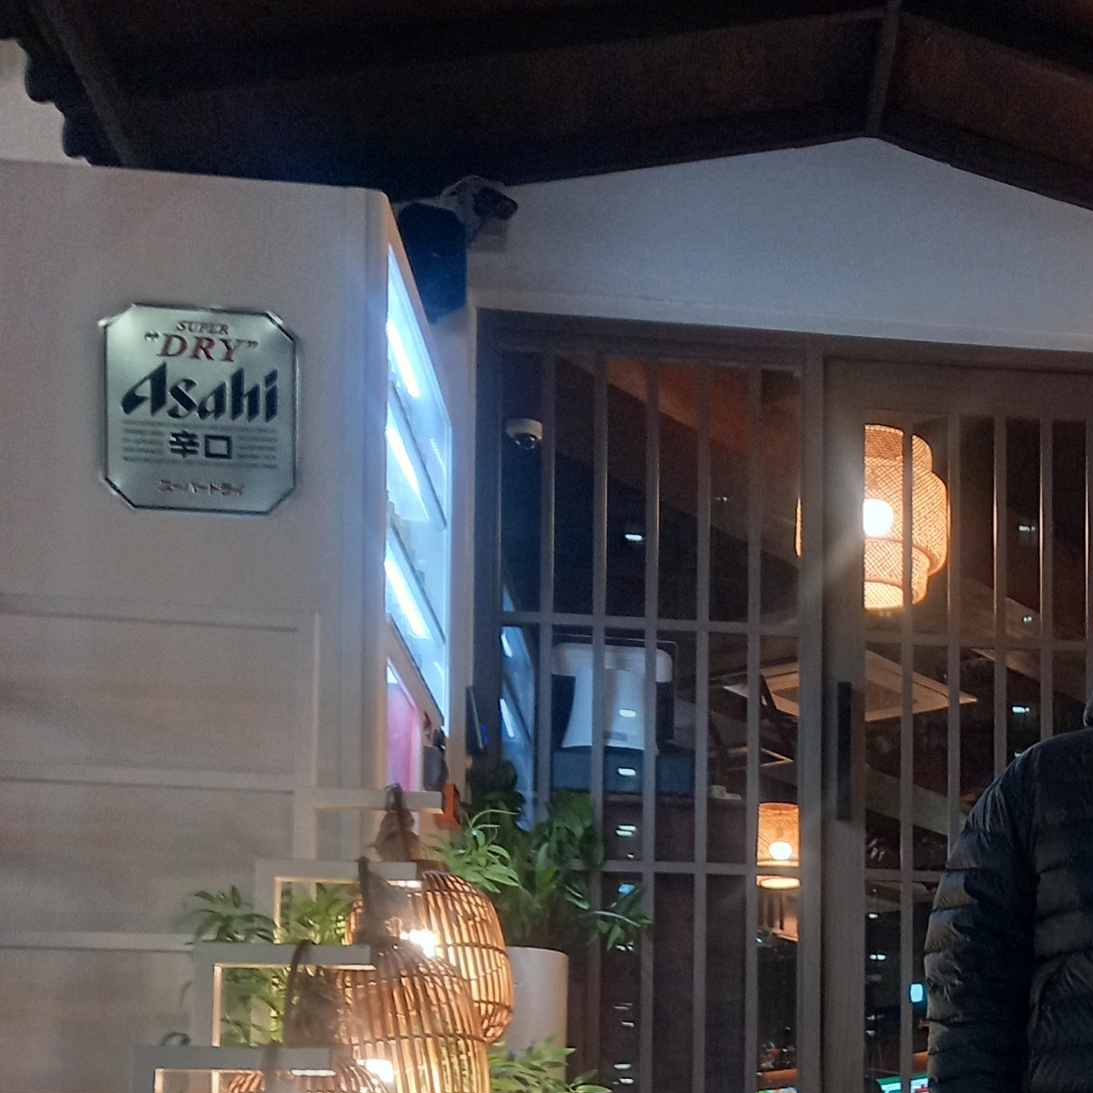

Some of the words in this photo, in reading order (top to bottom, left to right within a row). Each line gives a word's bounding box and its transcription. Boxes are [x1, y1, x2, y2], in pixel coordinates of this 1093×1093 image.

[176, 320, 229, 335] SUPER
[120, 361, 279, 423] Asahi
[169, 430, 232, 460] 辛口
